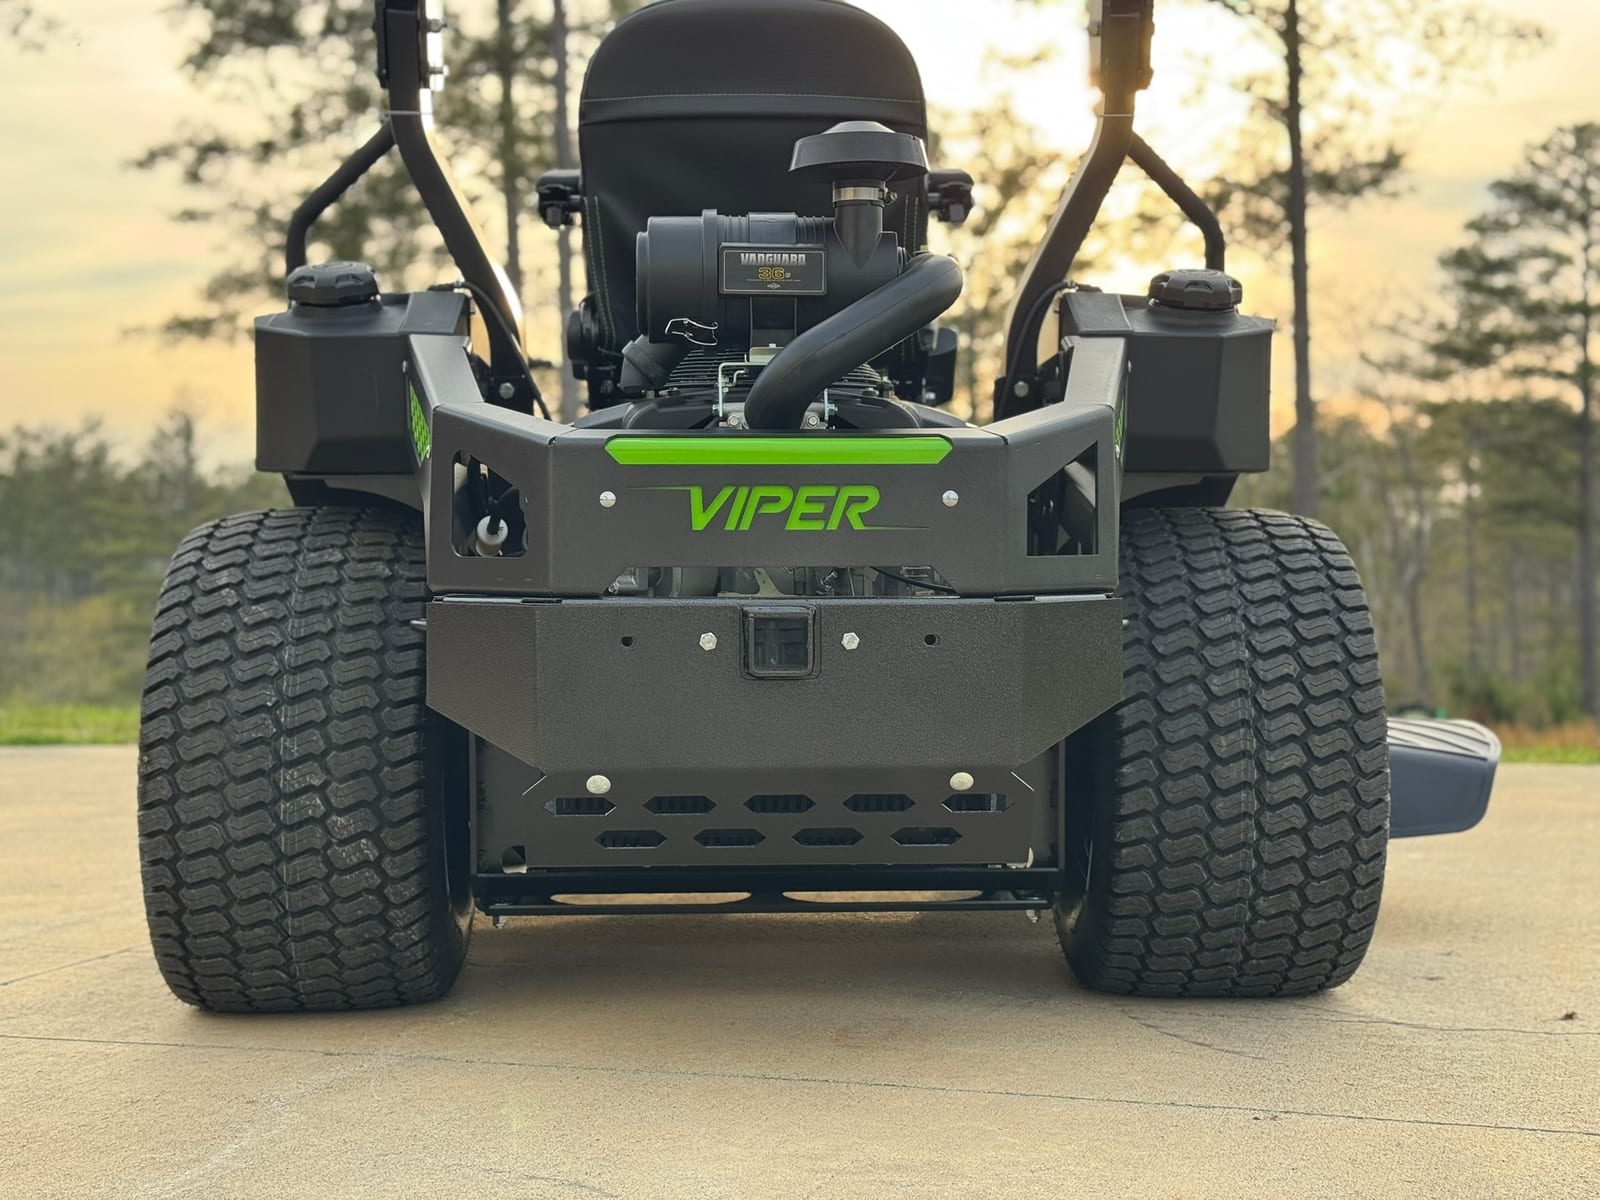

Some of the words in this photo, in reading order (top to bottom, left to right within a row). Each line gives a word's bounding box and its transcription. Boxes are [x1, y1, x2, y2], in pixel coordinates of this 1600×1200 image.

[740, 253, 806, 266] VANGUARD
[758, 267, 785, 280] 36
[687, 485, 881, 531] VIPER
